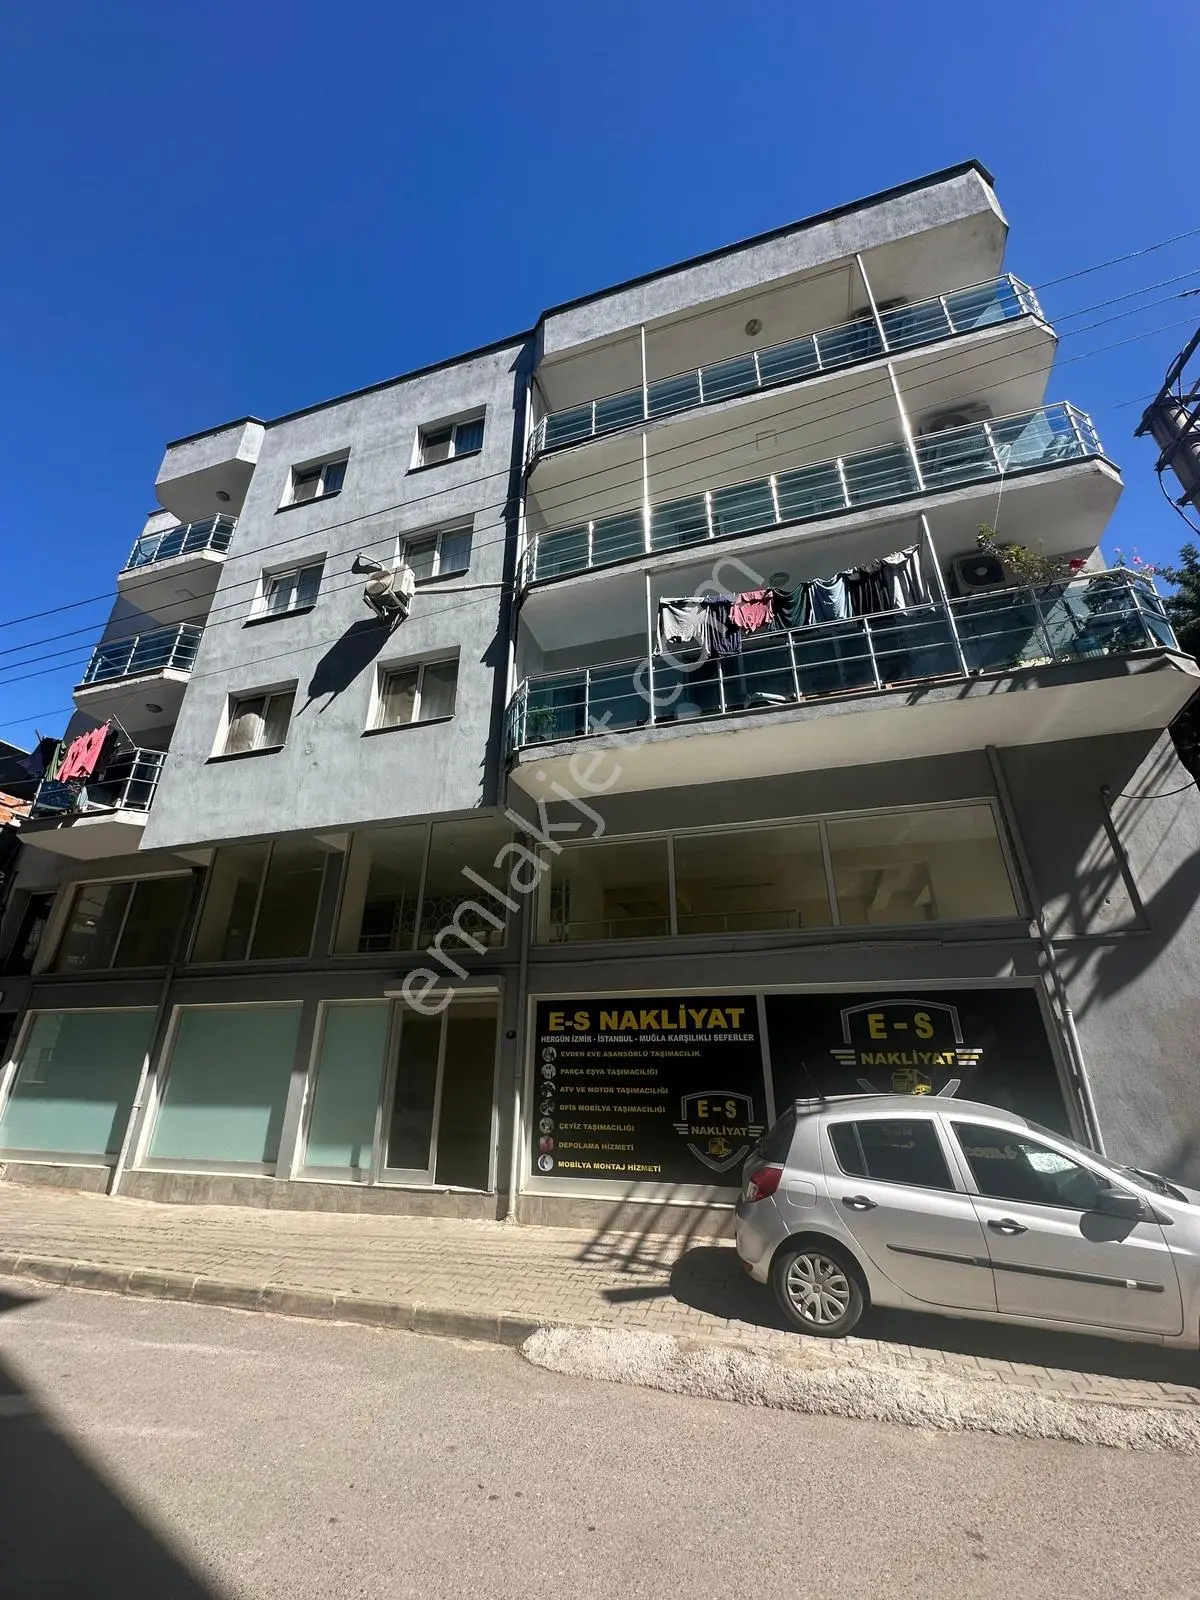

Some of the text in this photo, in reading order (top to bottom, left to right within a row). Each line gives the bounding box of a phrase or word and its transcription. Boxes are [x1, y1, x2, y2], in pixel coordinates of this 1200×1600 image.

[549, 1004, 745, 1031] E-S NAKLİYAT
[541, 1034, 570, 1043] HERGÜN
[571, 1034, 592, 1042] İZMİR
[598, 1033, 633, 1042] İSTANBUL
[639, 1033, 666, 1042] MUĞLA
[667, 1033, 712, 1043] KARŞILIKLI
[713, 1033, 755, 1041] SEFERLER
[651, 1050, 701, 1058] TAŞIMACILIK
[861, 1050, 955, 1065] NAKLİYAT
[560, 1068, 584, 1076] PARÇA
[586, 1068, 605, 1076] EŞYA
[616, 1086, 669, 1095] TAŞIMACILIĞI
[578, 1104, 611, 1112] MOBİLYA
[613, 1105, 666, 1114] TAŞIMACILIĞI
[559, 1122, 635, 1132] ÇEYİZ TAŞIMACILIĞI
[691, 1125, 748, 1137] NAKLİYAT
[559, 1142, 634, 1152] DEPOLAMA HİZMETİ
[558, 1160, 662, 1173] MOBİLYA MONTAJ HİZMETİ
